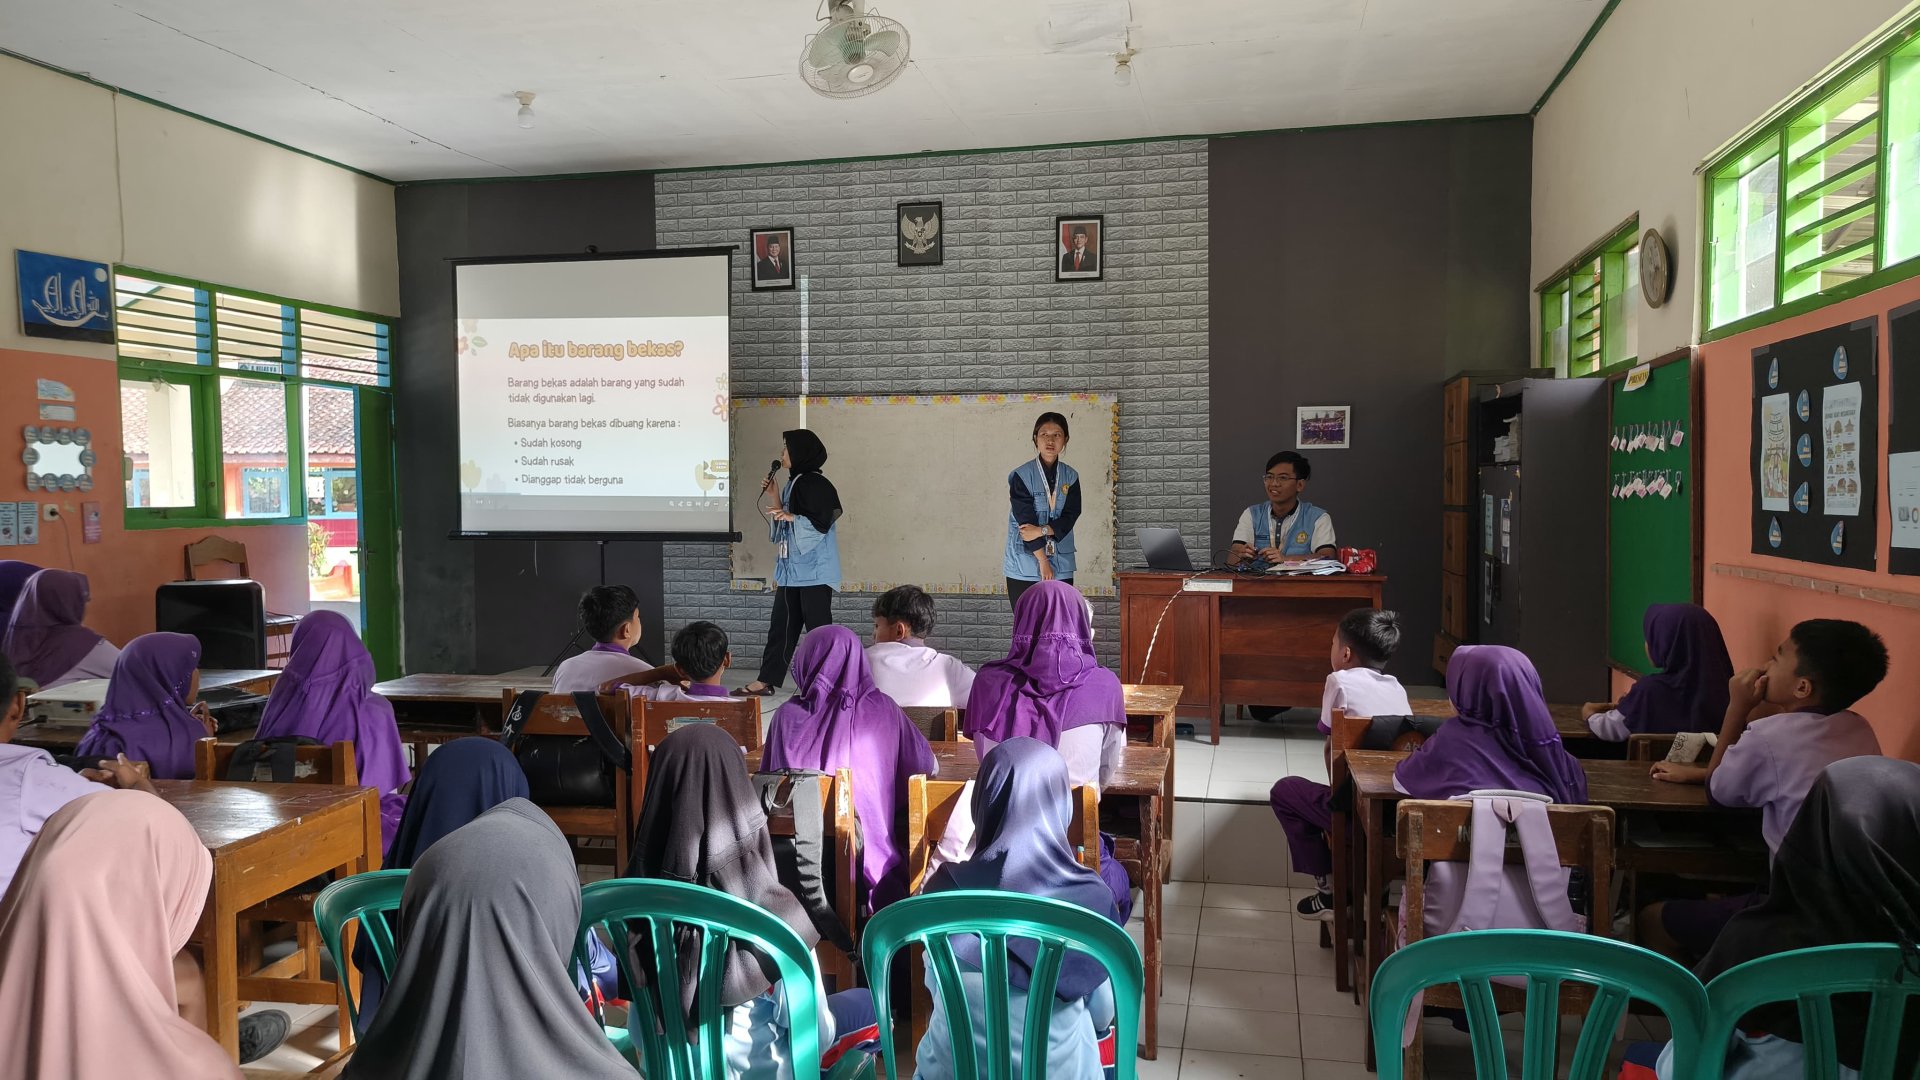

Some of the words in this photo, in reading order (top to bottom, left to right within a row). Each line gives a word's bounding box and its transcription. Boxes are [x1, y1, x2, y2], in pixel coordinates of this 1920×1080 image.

[508, 341, 539, 361] Apa
[542, 339, 565, 358] itu
[567, 341, 624, 361] barang
[627, 340, 684, 357] bekas?
[508, 377, 539, 389] Barang
[541, 377, 567, 388] bekas
[569, 377, 599, 388] adalah
[601, 377, 632, 389] barang
[634, 379, 656, 390] yang
[658, 377, 685, 388] sudah
[508, 393, 530, 403] tidak
[533, 393, 577, 404] digunakan
[579, 393, 596, 405] lagi.
[508, 417, 546, 430] Biasanya
[548, 418, 579, 430] barang
[581, 418, 607, 428] bekas
[609, 418, 644, 430] dibuang
[646, 418, 676, 428] karena
[520, 438, 548, 448] Sudah
[550, 438, 582, 449] kosong
[521, 456, 548, 466] Sudah
[550, 456, 574, 466] rusak
[521, 474, 561, 486] Dianggap
[564, 474, 586, 485] tidak
[588, 474, 624, 486] berguna
